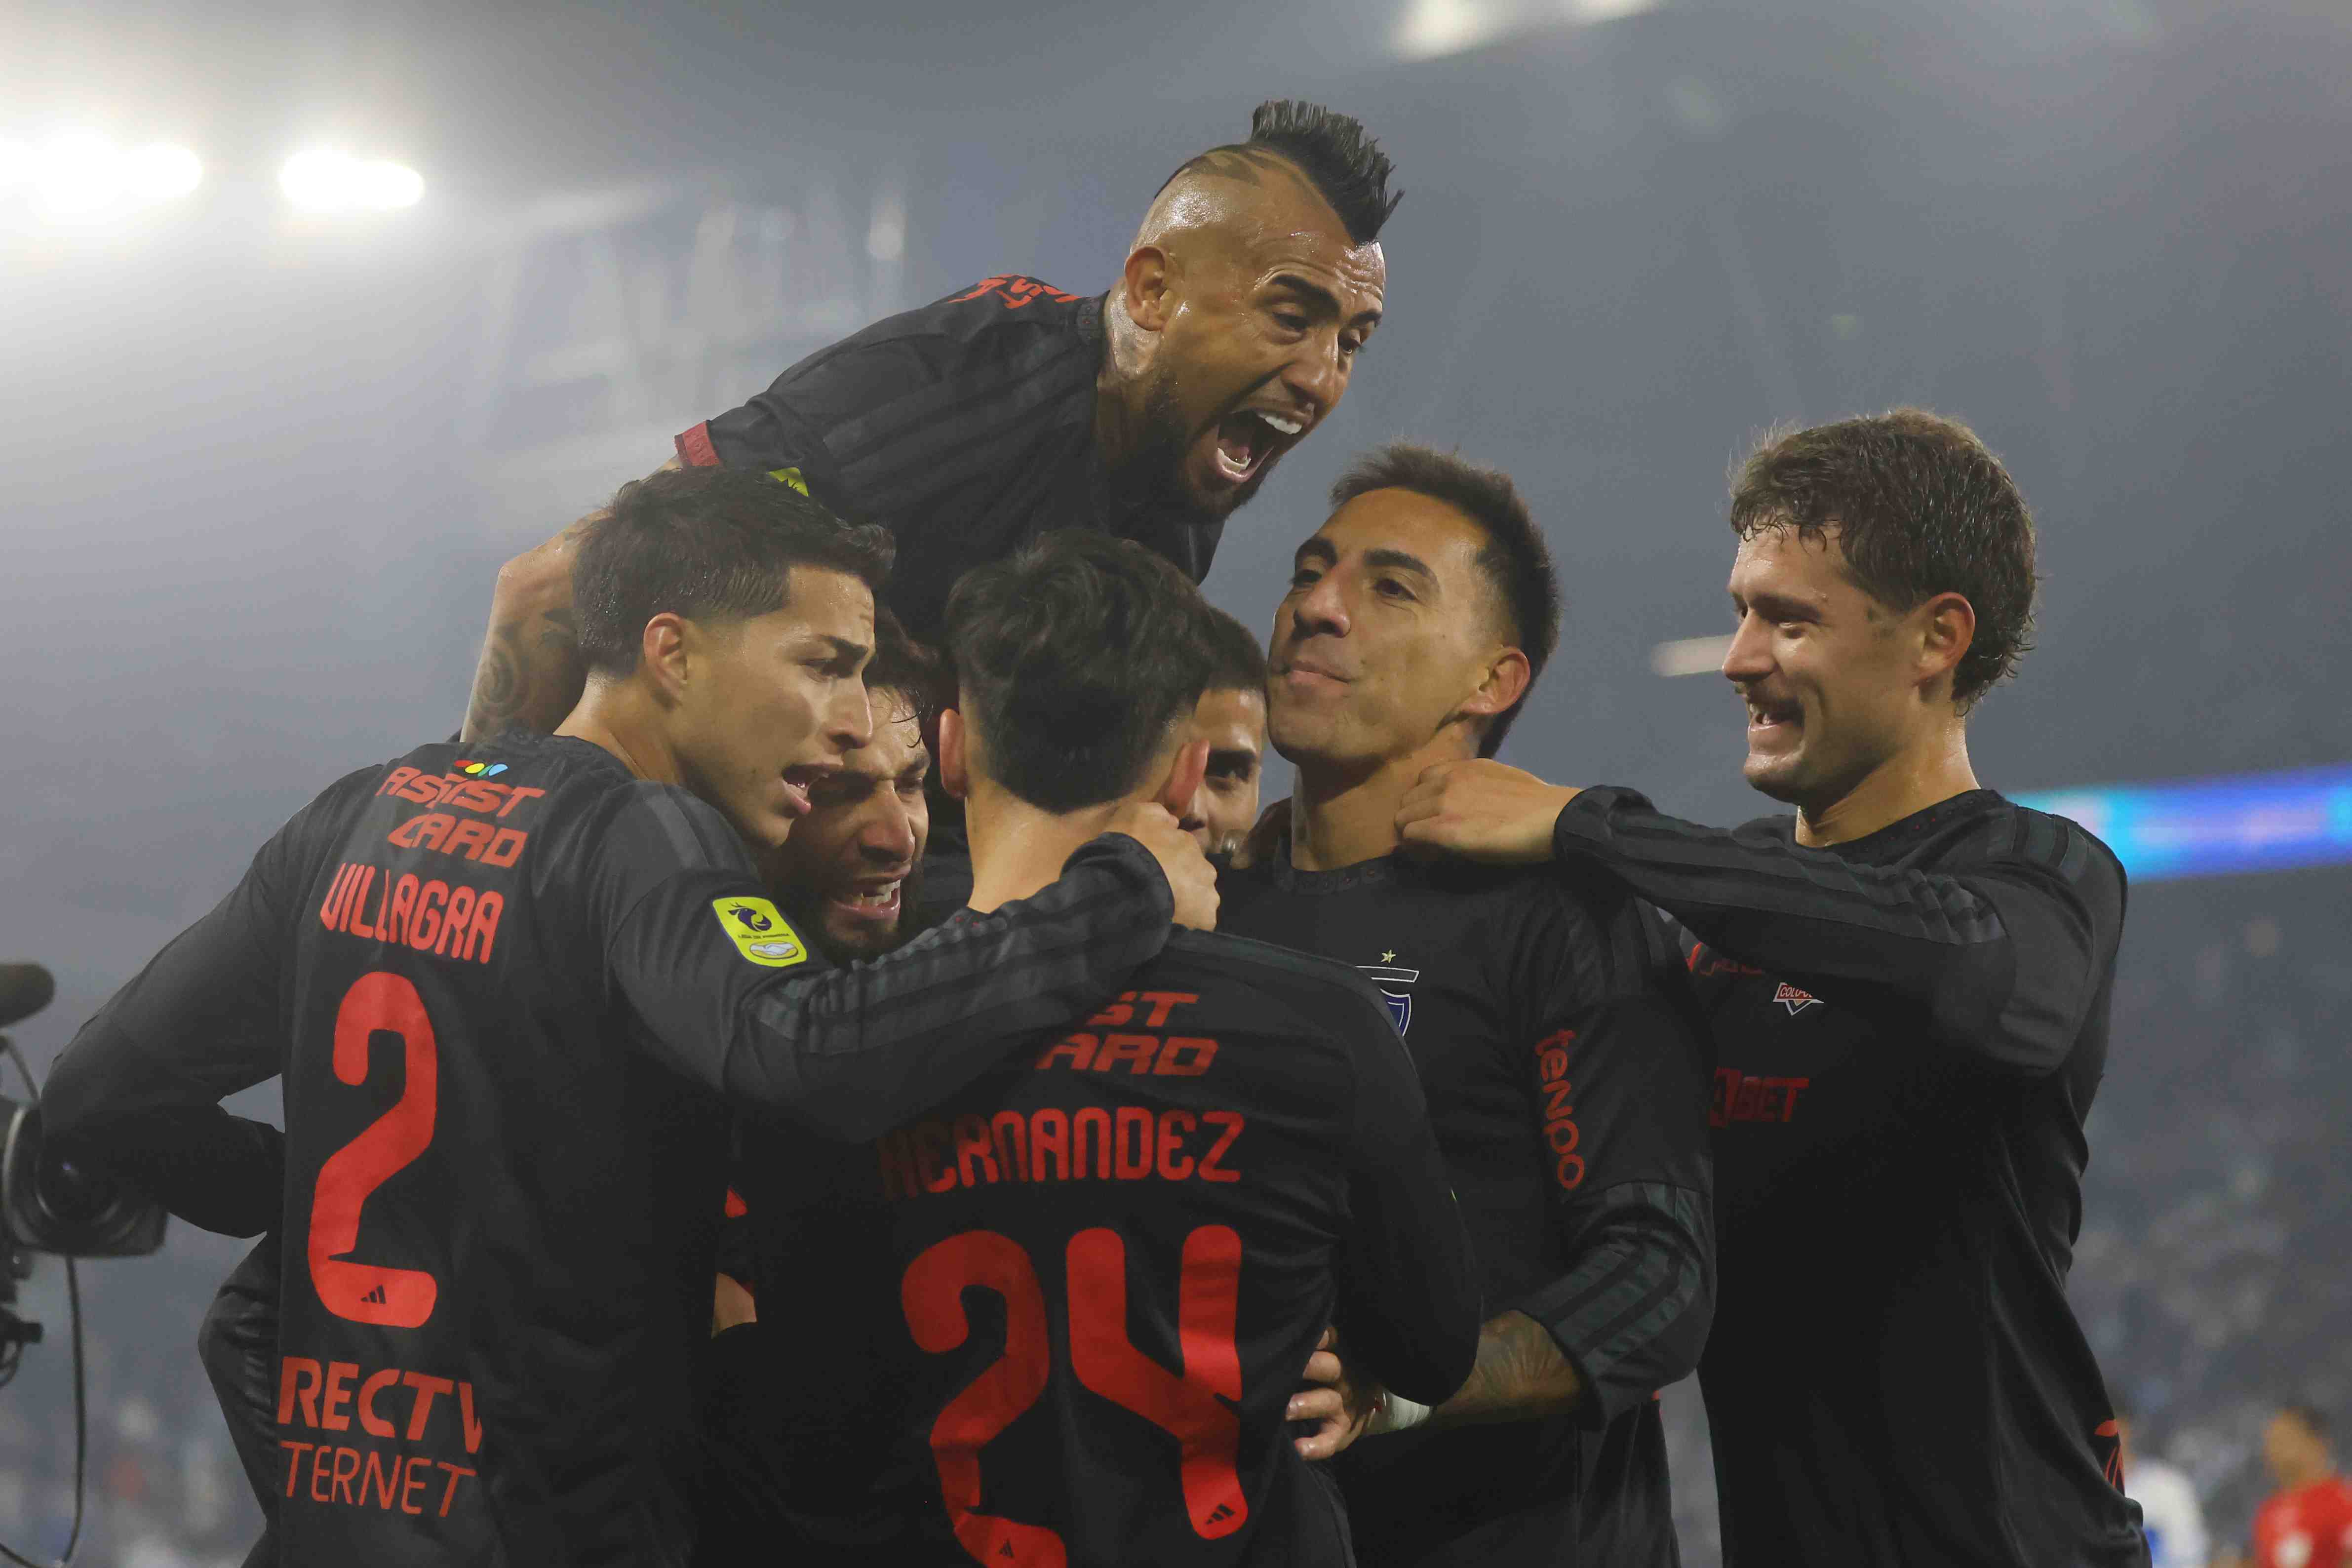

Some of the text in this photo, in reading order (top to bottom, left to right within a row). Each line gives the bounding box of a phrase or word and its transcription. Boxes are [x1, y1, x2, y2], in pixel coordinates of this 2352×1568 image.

[388, 813, 528, 868] CARD
[320, 862, 504, 964] VILLAGRA
[308, 971, 438, 1328] 2
[877, 1105, 1245, 1200] HERNANDEZ
[902, 1224, 1249, 1568] 24
